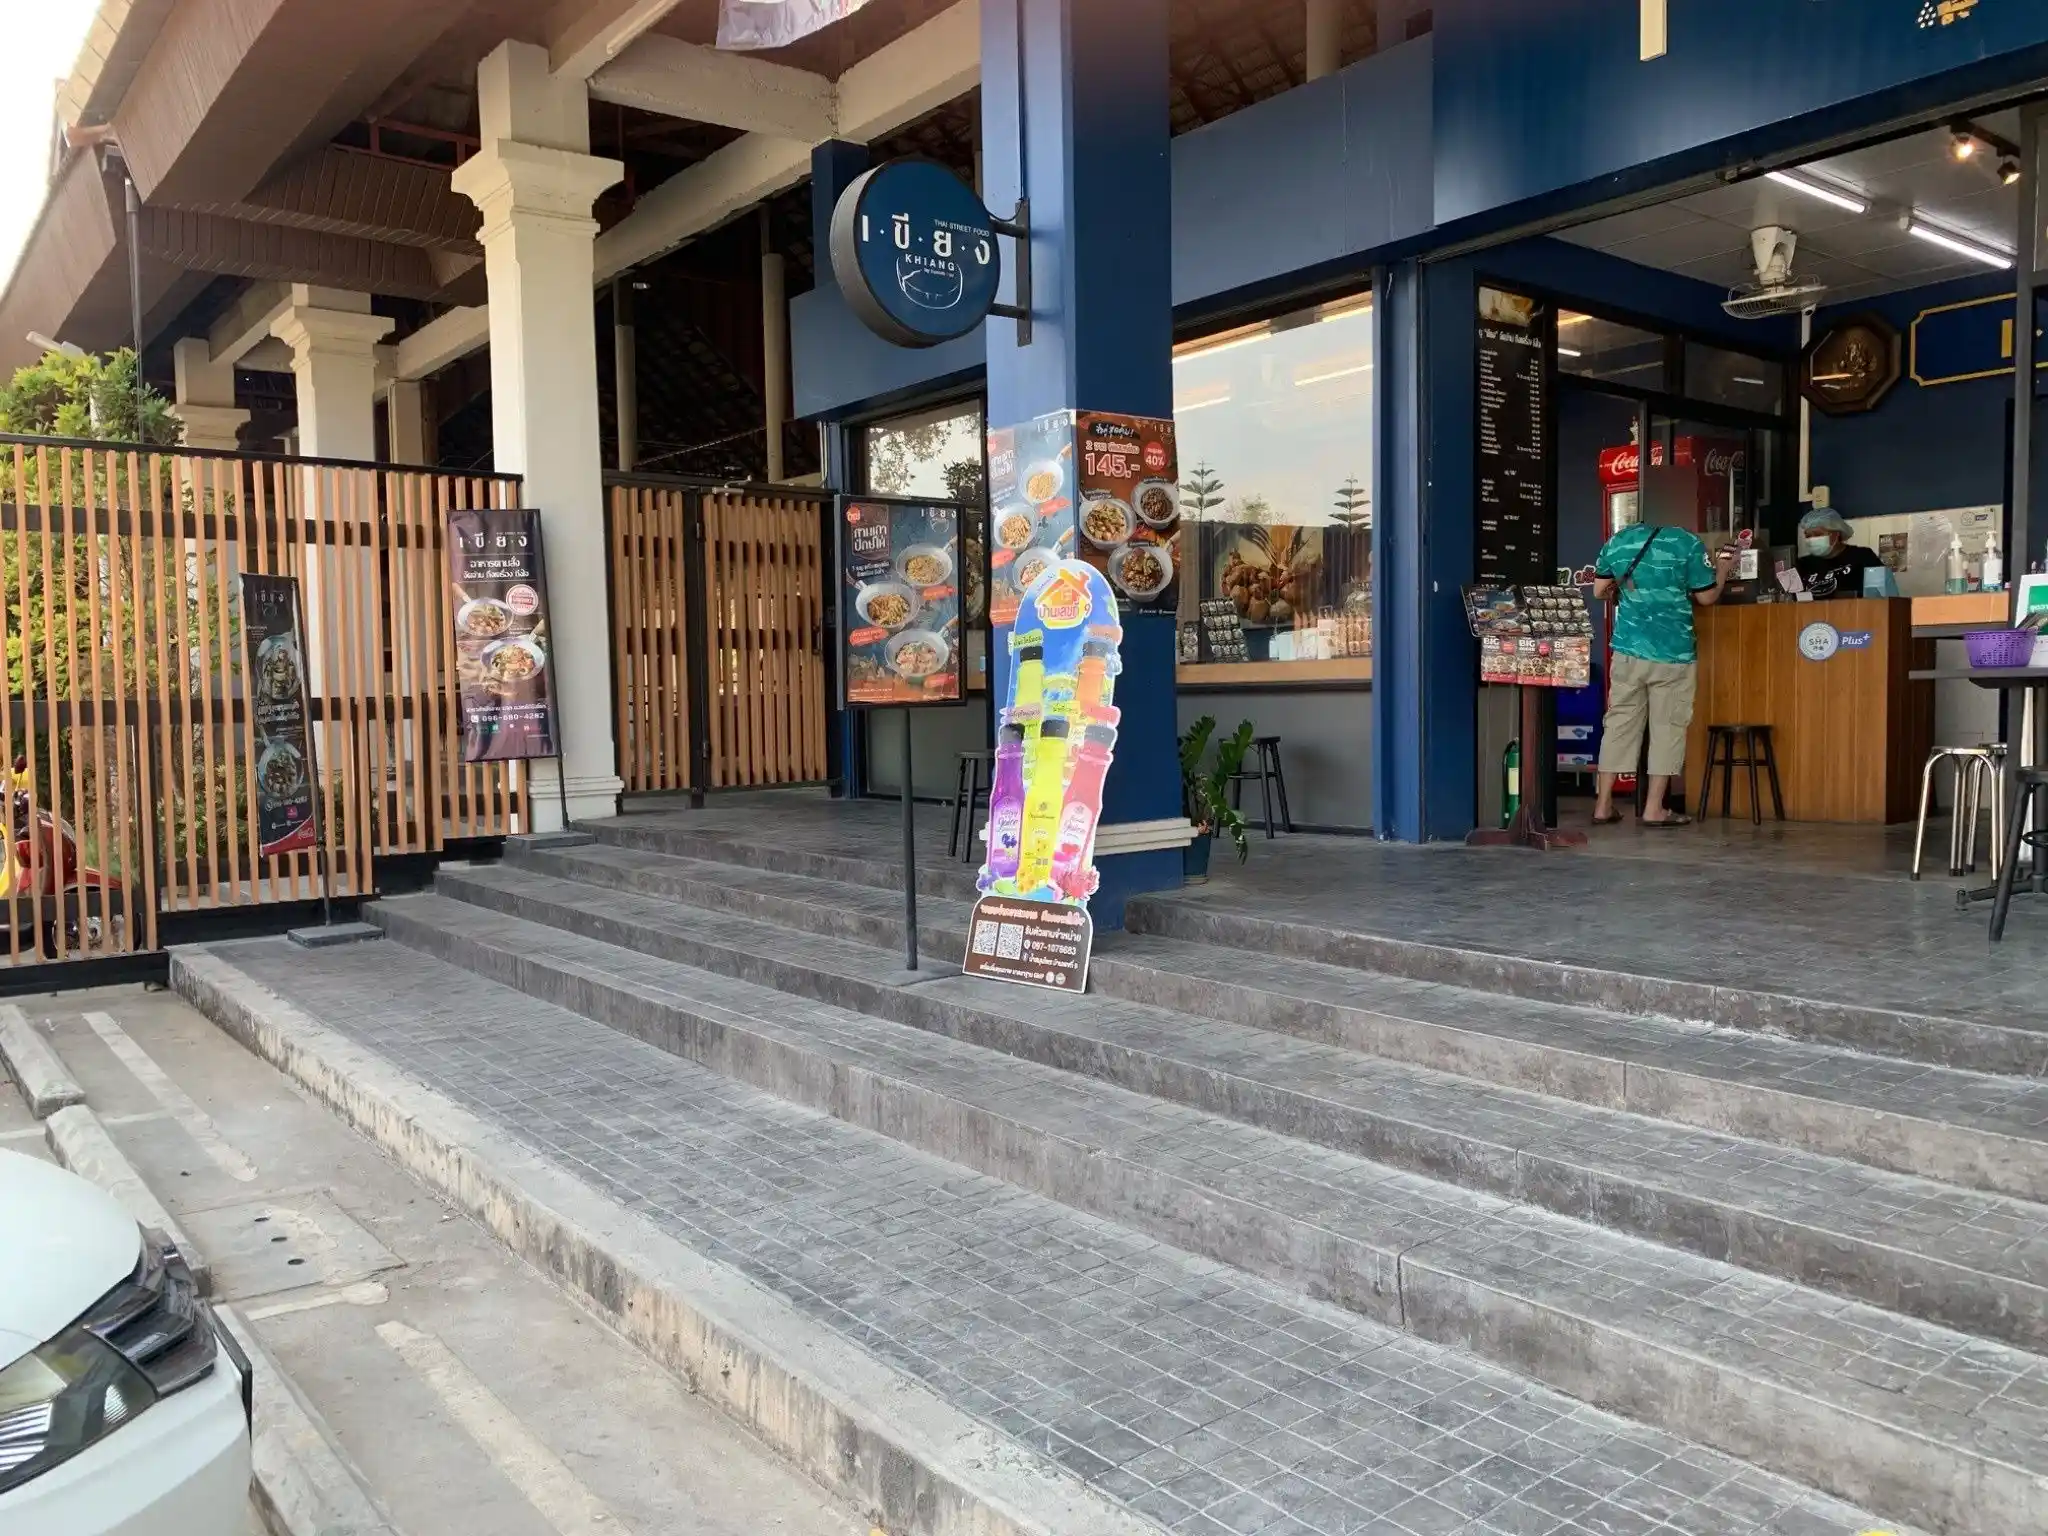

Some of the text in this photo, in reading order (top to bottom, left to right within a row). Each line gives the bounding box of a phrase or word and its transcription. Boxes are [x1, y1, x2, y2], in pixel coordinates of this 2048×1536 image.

[934, 219, 990, 237] THAI STREET FOOD
[905, 253, 955, 271] KHIANG
[1519, 640, 1535, 648] BIG
